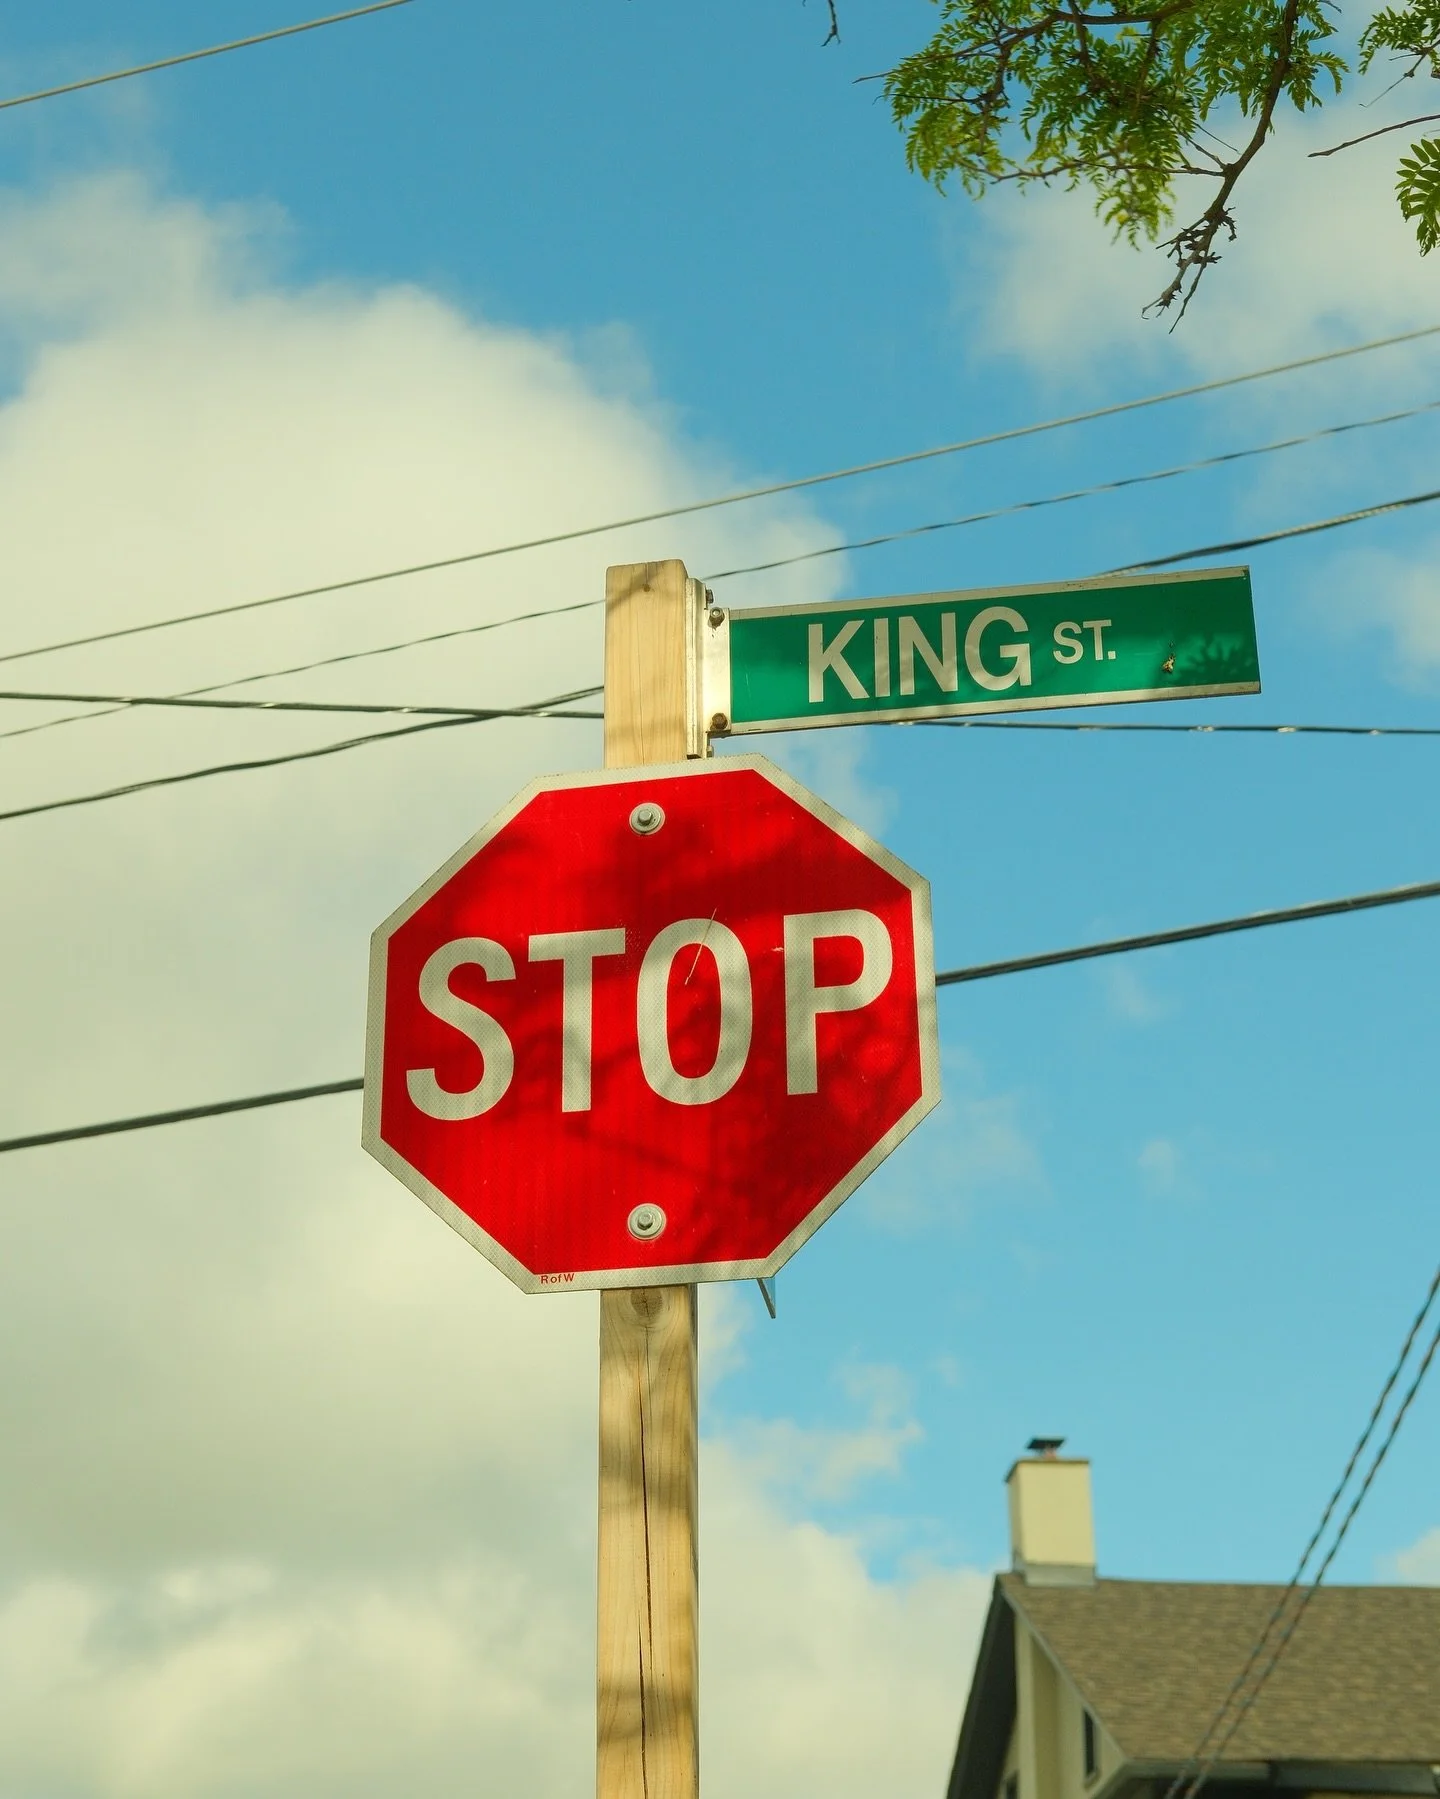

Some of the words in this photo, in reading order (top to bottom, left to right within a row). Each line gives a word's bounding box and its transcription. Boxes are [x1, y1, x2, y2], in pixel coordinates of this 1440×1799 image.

[807, 606, 1031, 703] KING
[1053, 619, 1116, 664] ST.
[405, 908, 893, 1121] STOP
